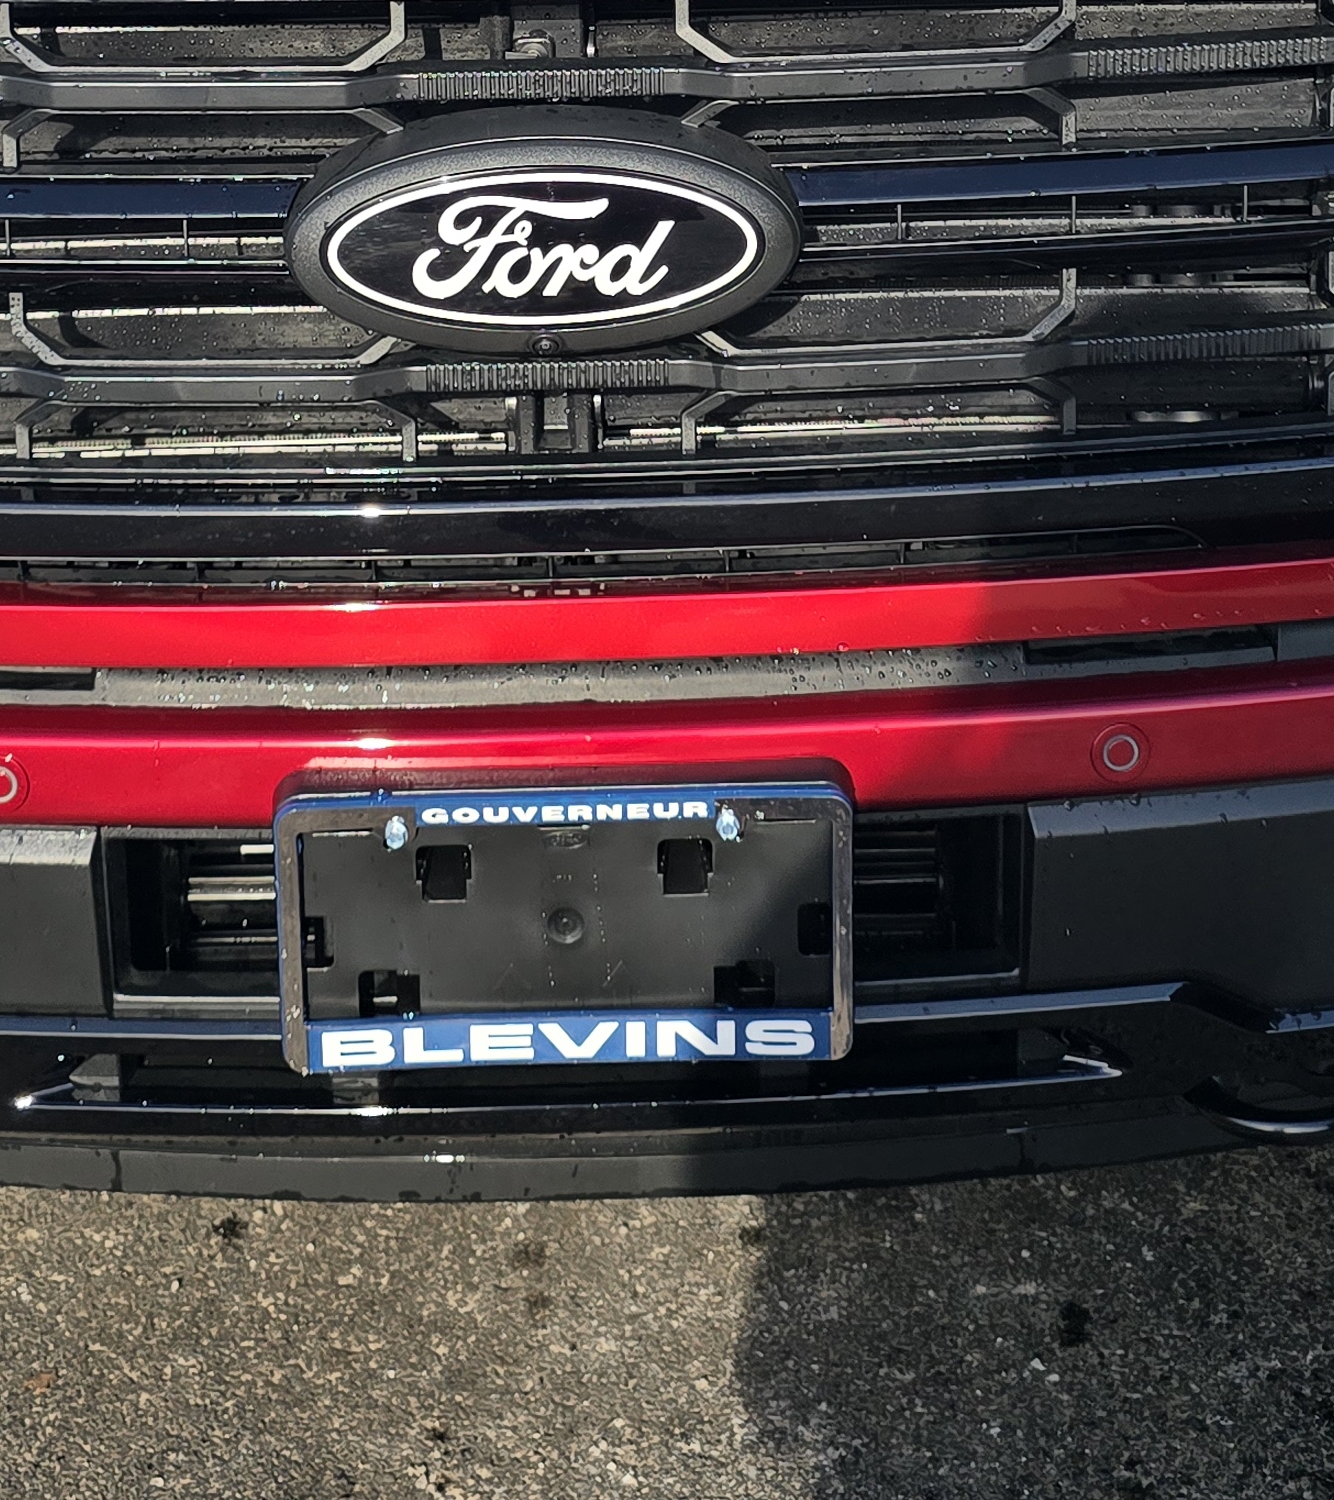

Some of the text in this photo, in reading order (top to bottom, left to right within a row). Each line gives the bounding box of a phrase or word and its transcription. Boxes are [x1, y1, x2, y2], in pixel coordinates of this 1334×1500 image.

[412, 196, 675, 299] Ford
[420, 801, 709, 825] GOUVERNEUR
[320, 1019, 816, 1068] BLEVINS
